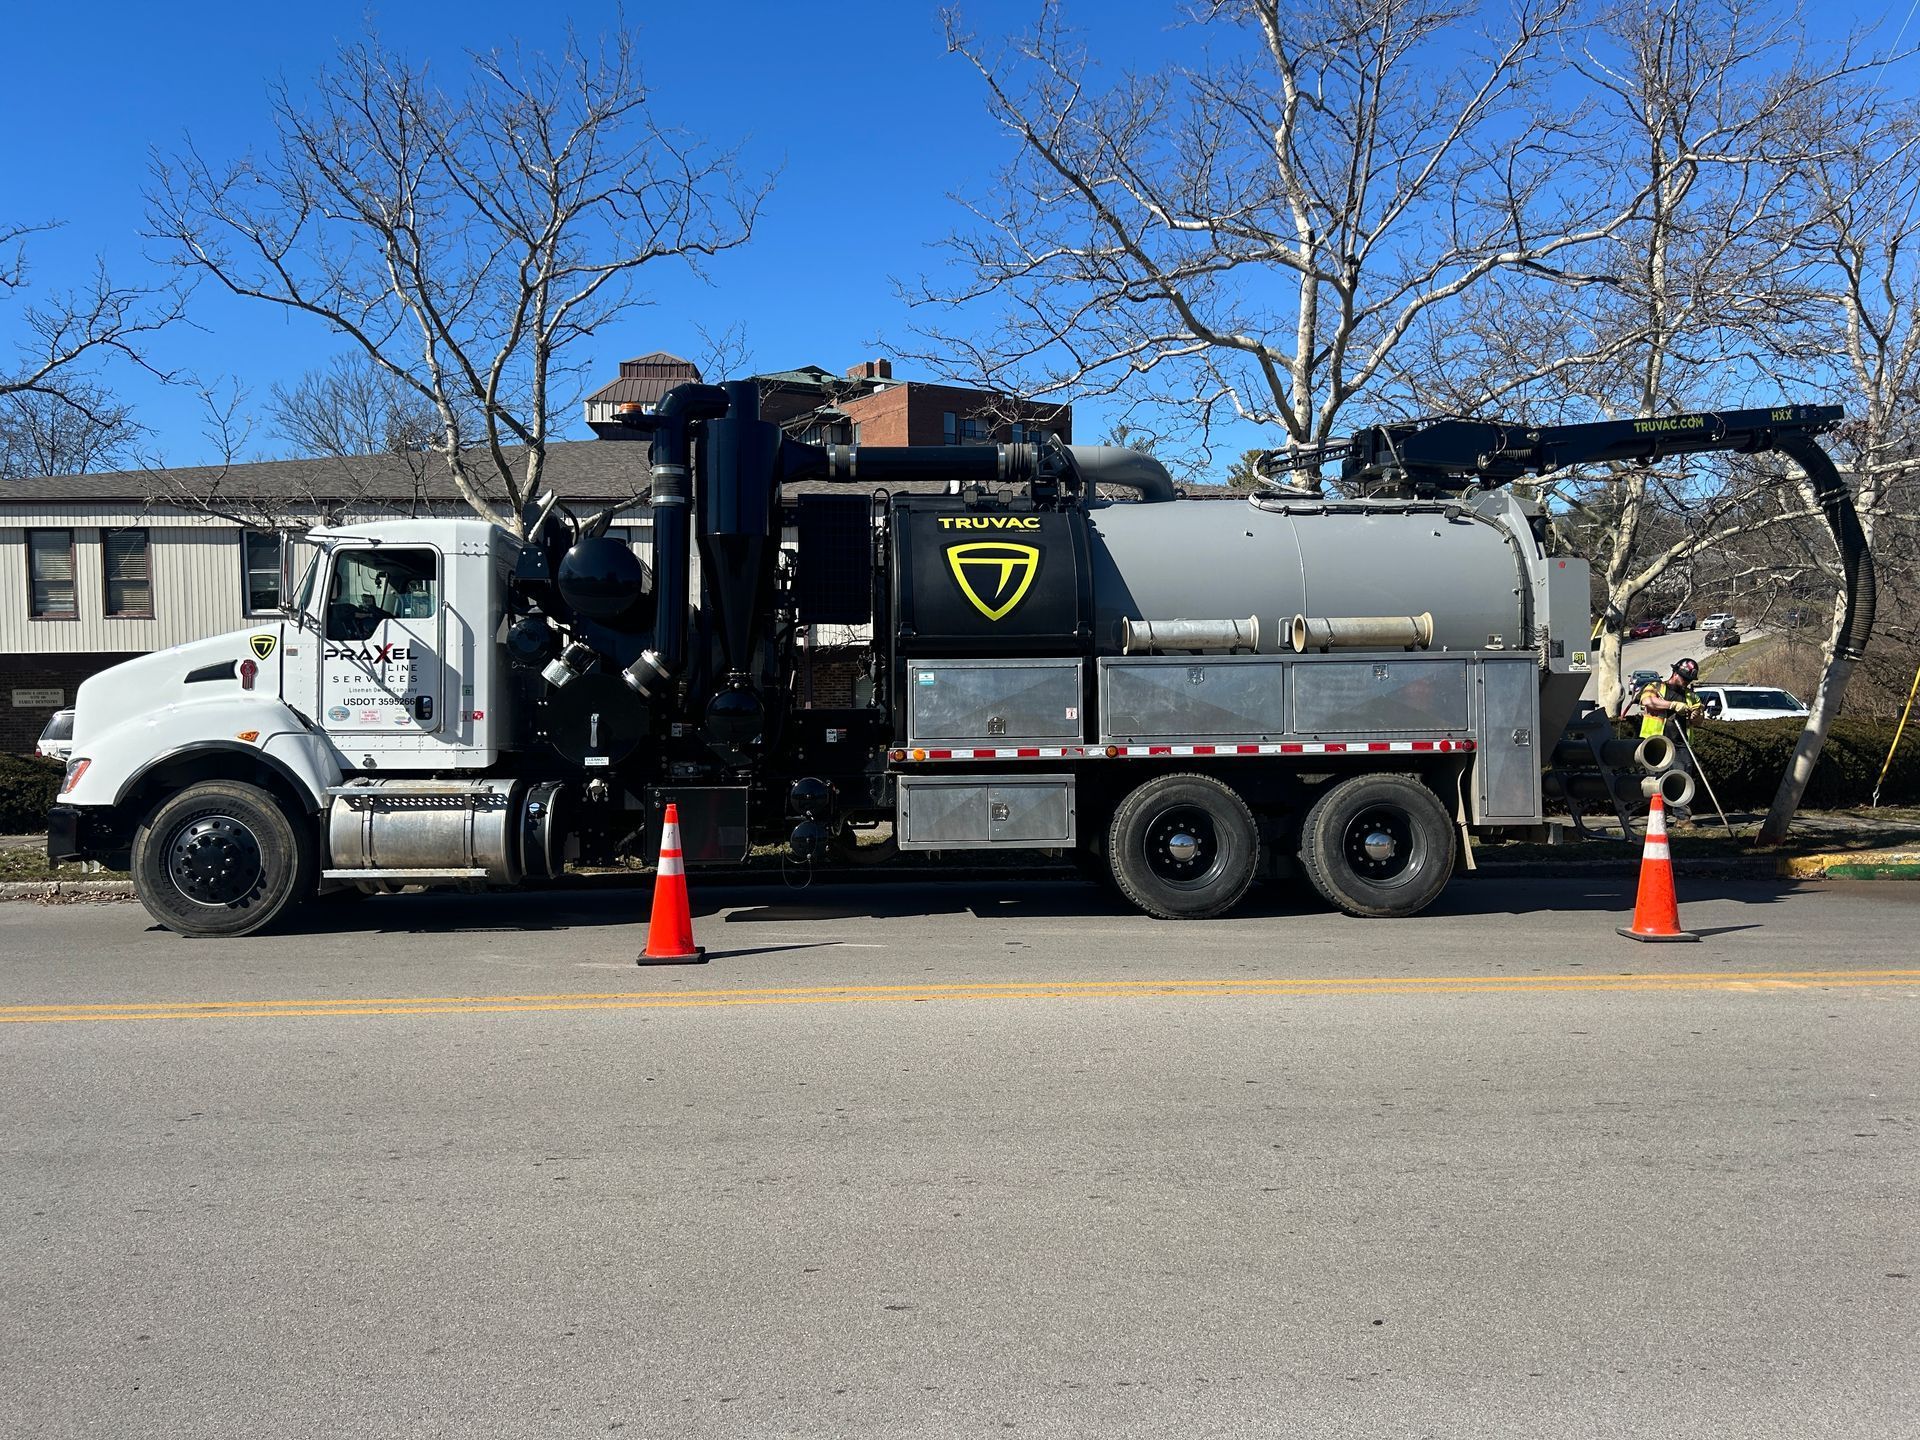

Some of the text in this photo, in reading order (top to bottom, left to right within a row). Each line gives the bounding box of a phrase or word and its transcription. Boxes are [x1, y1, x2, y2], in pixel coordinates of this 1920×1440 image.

[1771, 409, 1793, 421] HXX
[1633, 417, 1704, 433] TRUVAC.COM
[938, 517, 1041, 529] TRUVAC
[324, 643, 419, 664] PRAXEL
[387, 664, 418, 672] LINE
[332, 675, 418, 684] SERVICES
[392, 686, 418, 695] Company
[343, 697, 416, 706] USDOT 3595266
